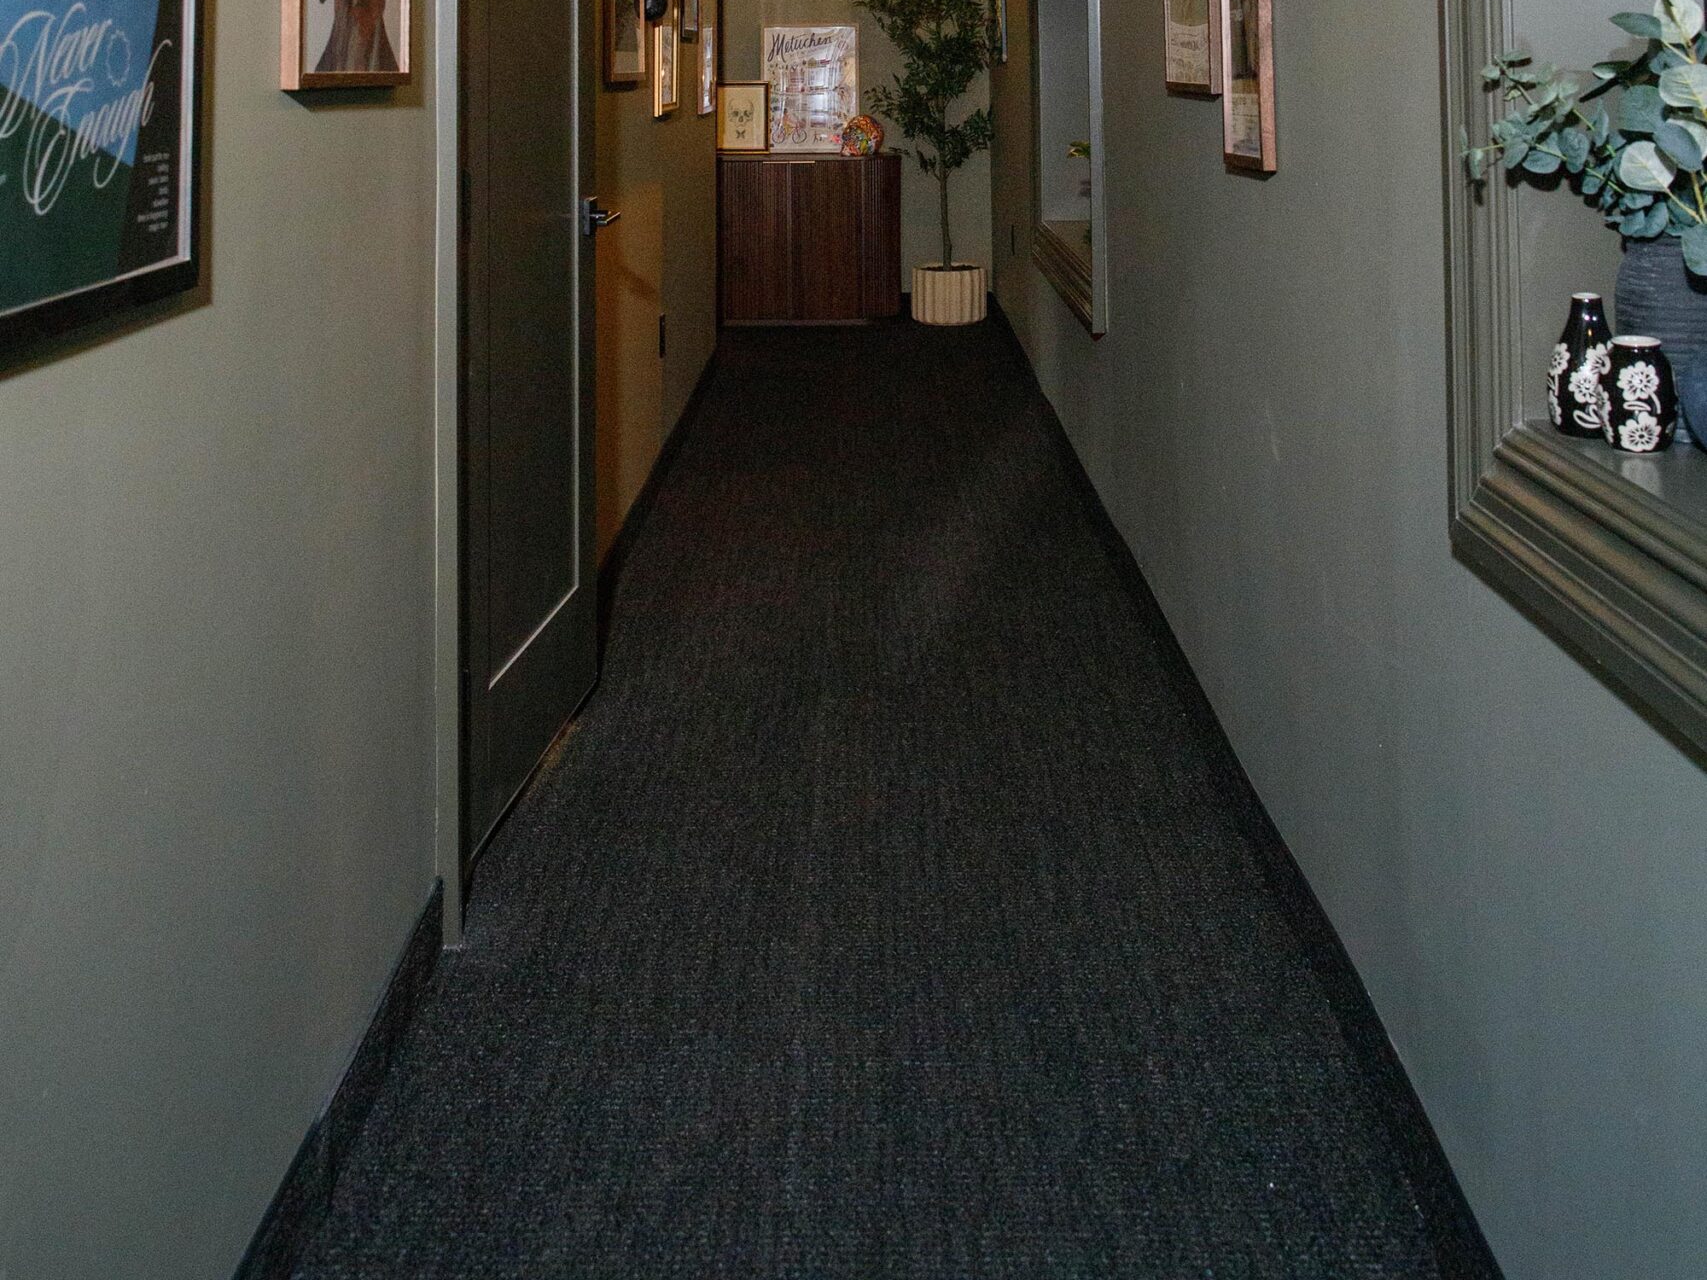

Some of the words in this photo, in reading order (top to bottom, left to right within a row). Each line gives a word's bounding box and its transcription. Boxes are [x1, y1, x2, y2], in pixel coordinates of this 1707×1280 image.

[0, 2, 112, 137] Never
[767, 33, 832, 63] Metuchen
[24, 40, 172, 215] Enough
